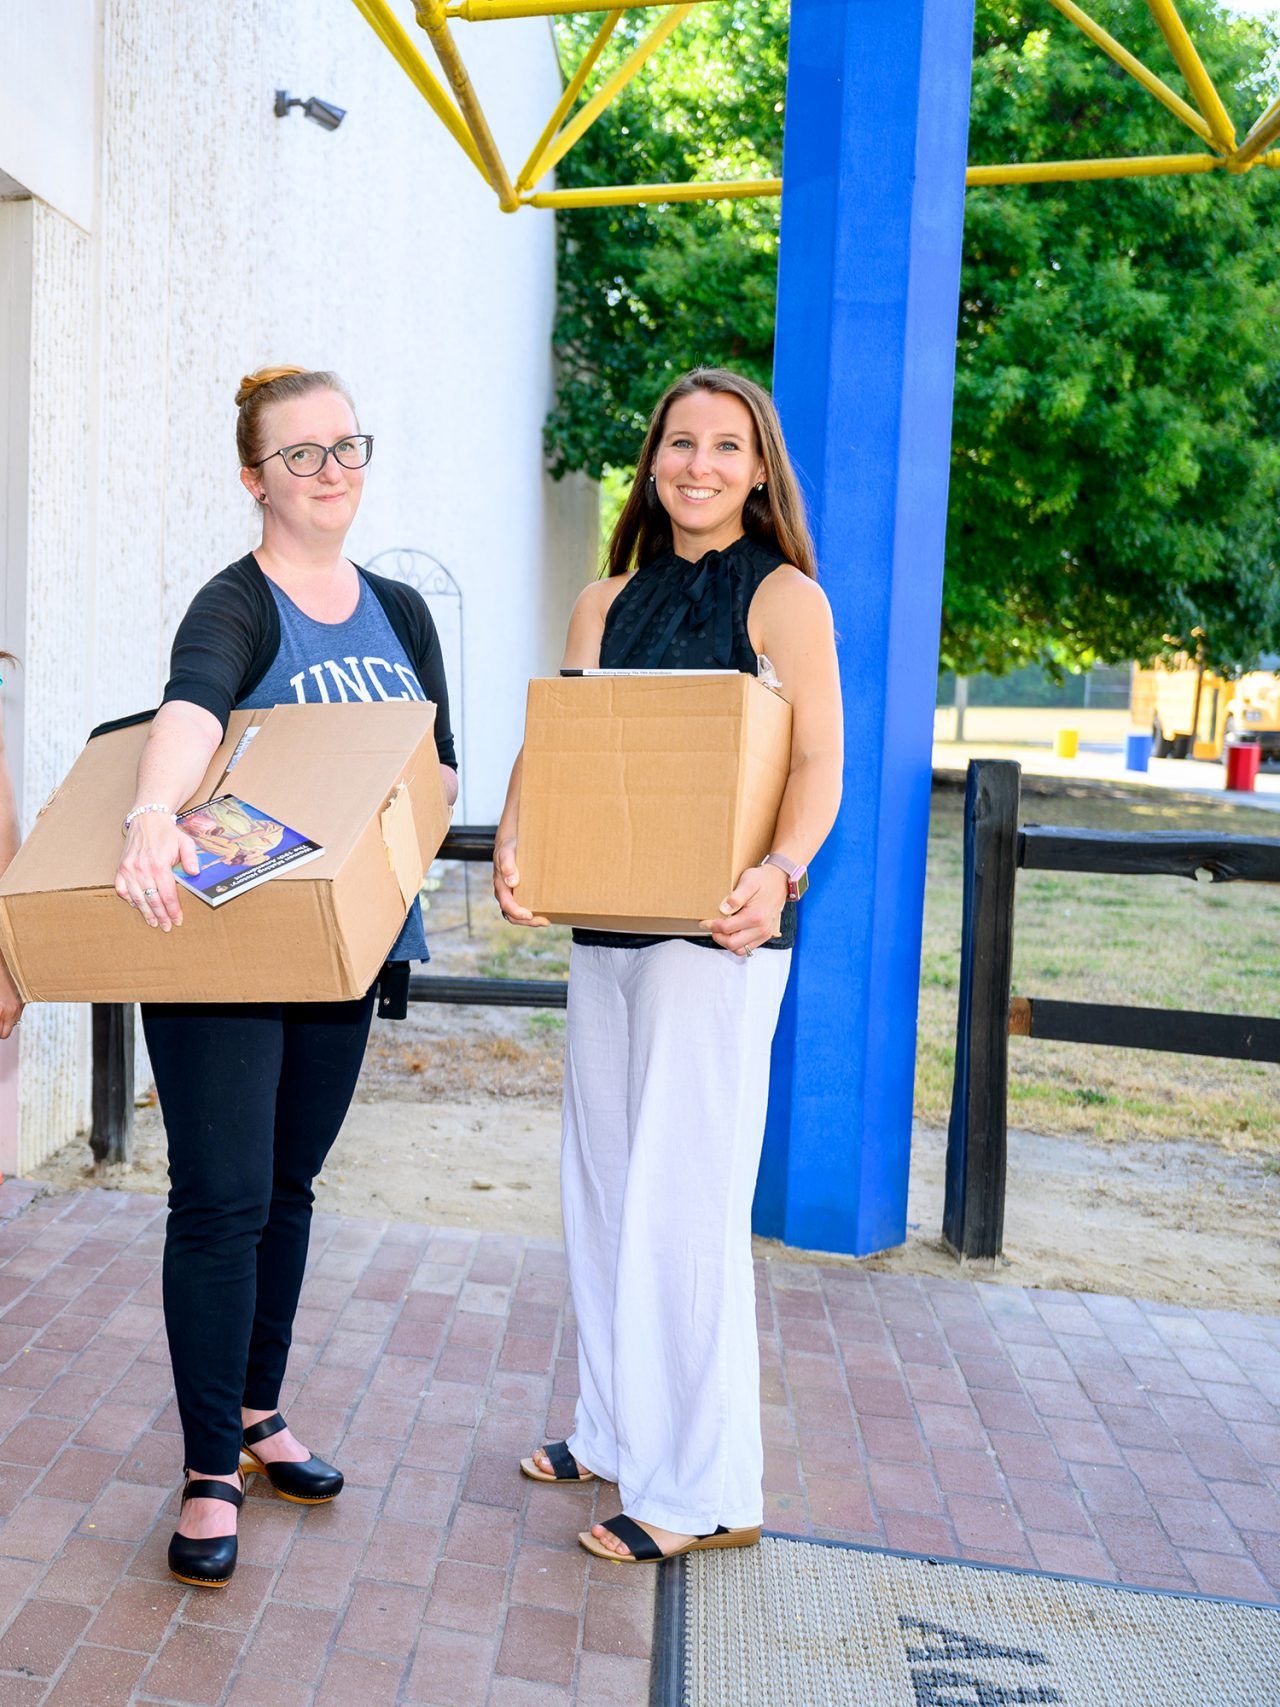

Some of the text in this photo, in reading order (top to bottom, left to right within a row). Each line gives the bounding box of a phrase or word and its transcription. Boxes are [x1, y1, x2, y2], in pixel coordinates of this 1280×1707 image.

[284, 847, 313, 861] Women
[293, 844, 309, 852] The
[234, 858, 276, 880] Amendment
[257, 860, 285, 874] Making
